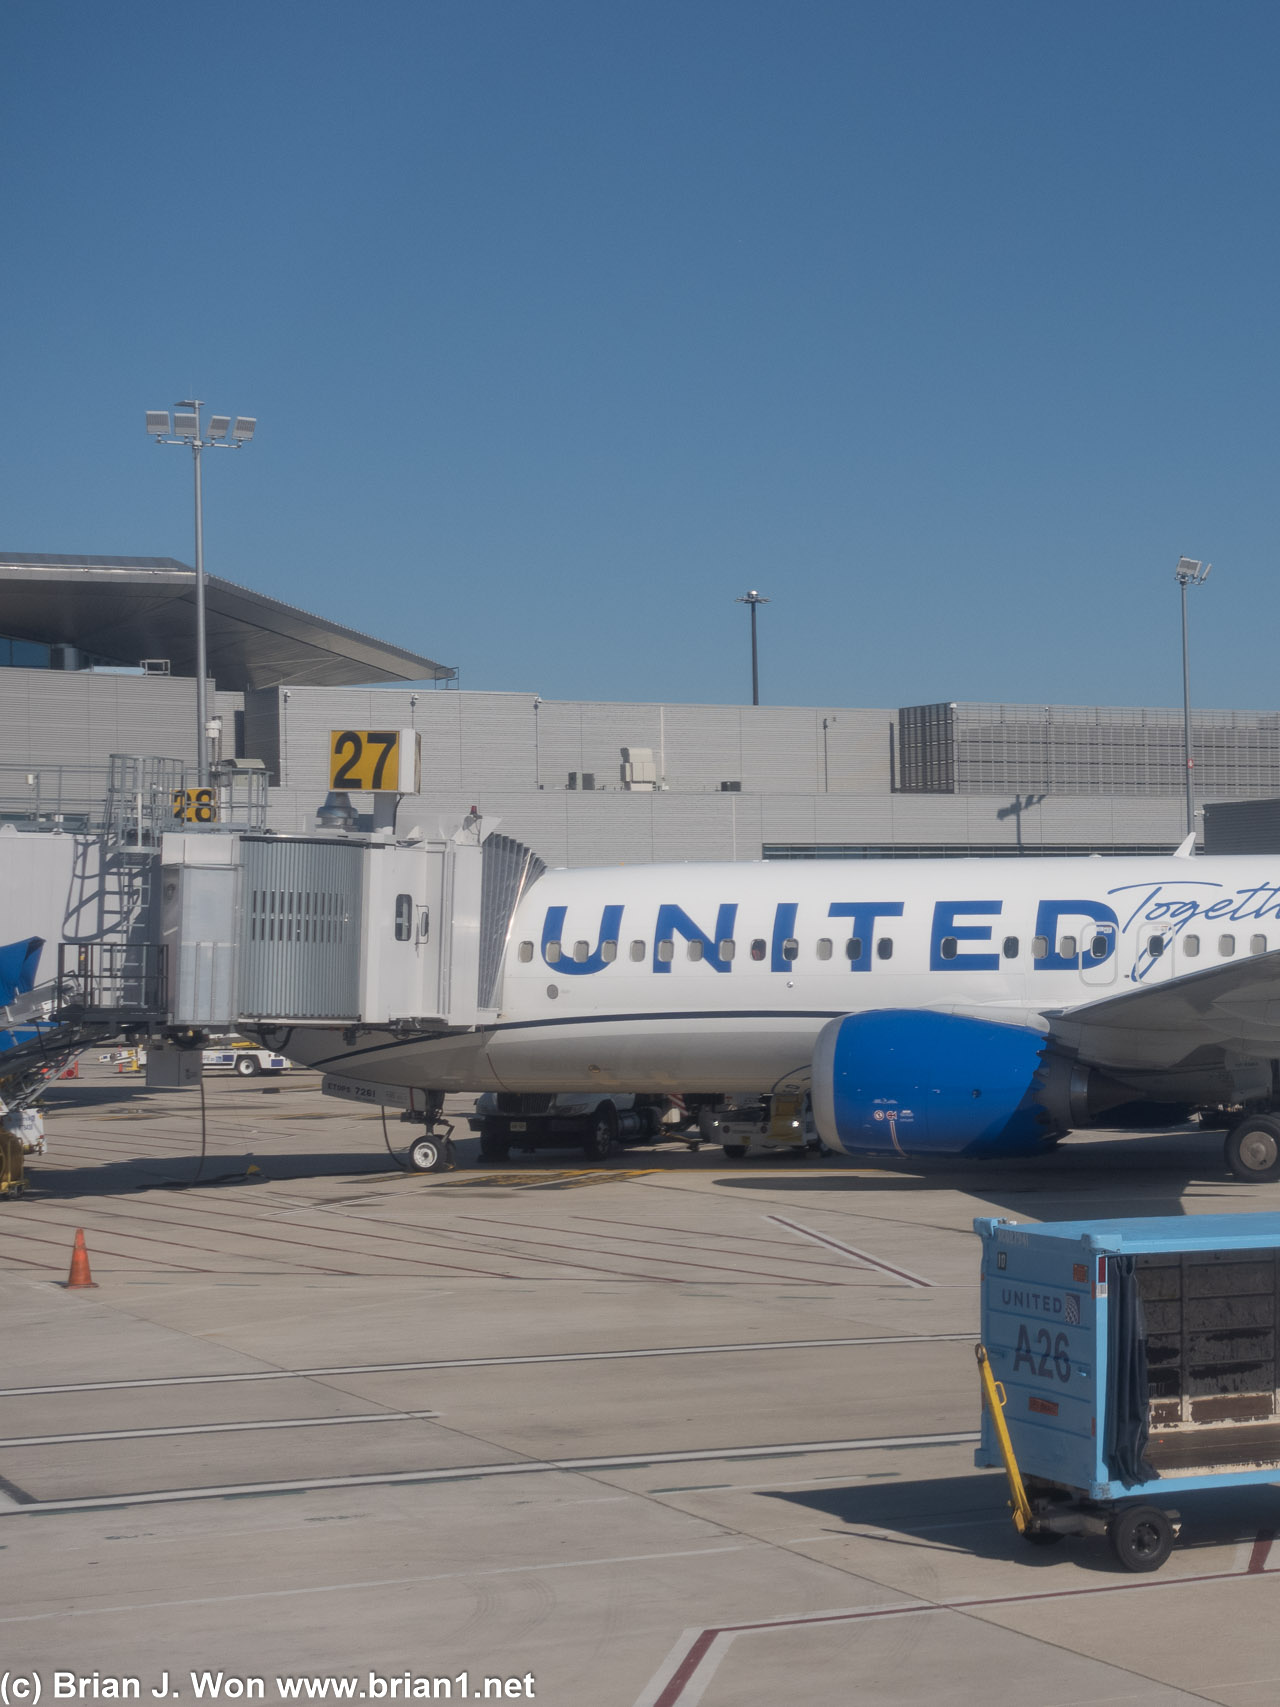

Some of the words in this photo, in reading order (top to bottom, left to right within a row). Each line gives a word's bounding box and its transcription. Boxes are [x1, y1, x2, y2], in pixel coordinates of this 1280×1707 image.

[333, 731, 397, 789] 27
[173, 789, 217, 823] 28
[542, 900, 1120, 975] UNITED
[1002, 1288, 1062, 1313] UNITED
[1012, 1324, 1071, 1383] A26
